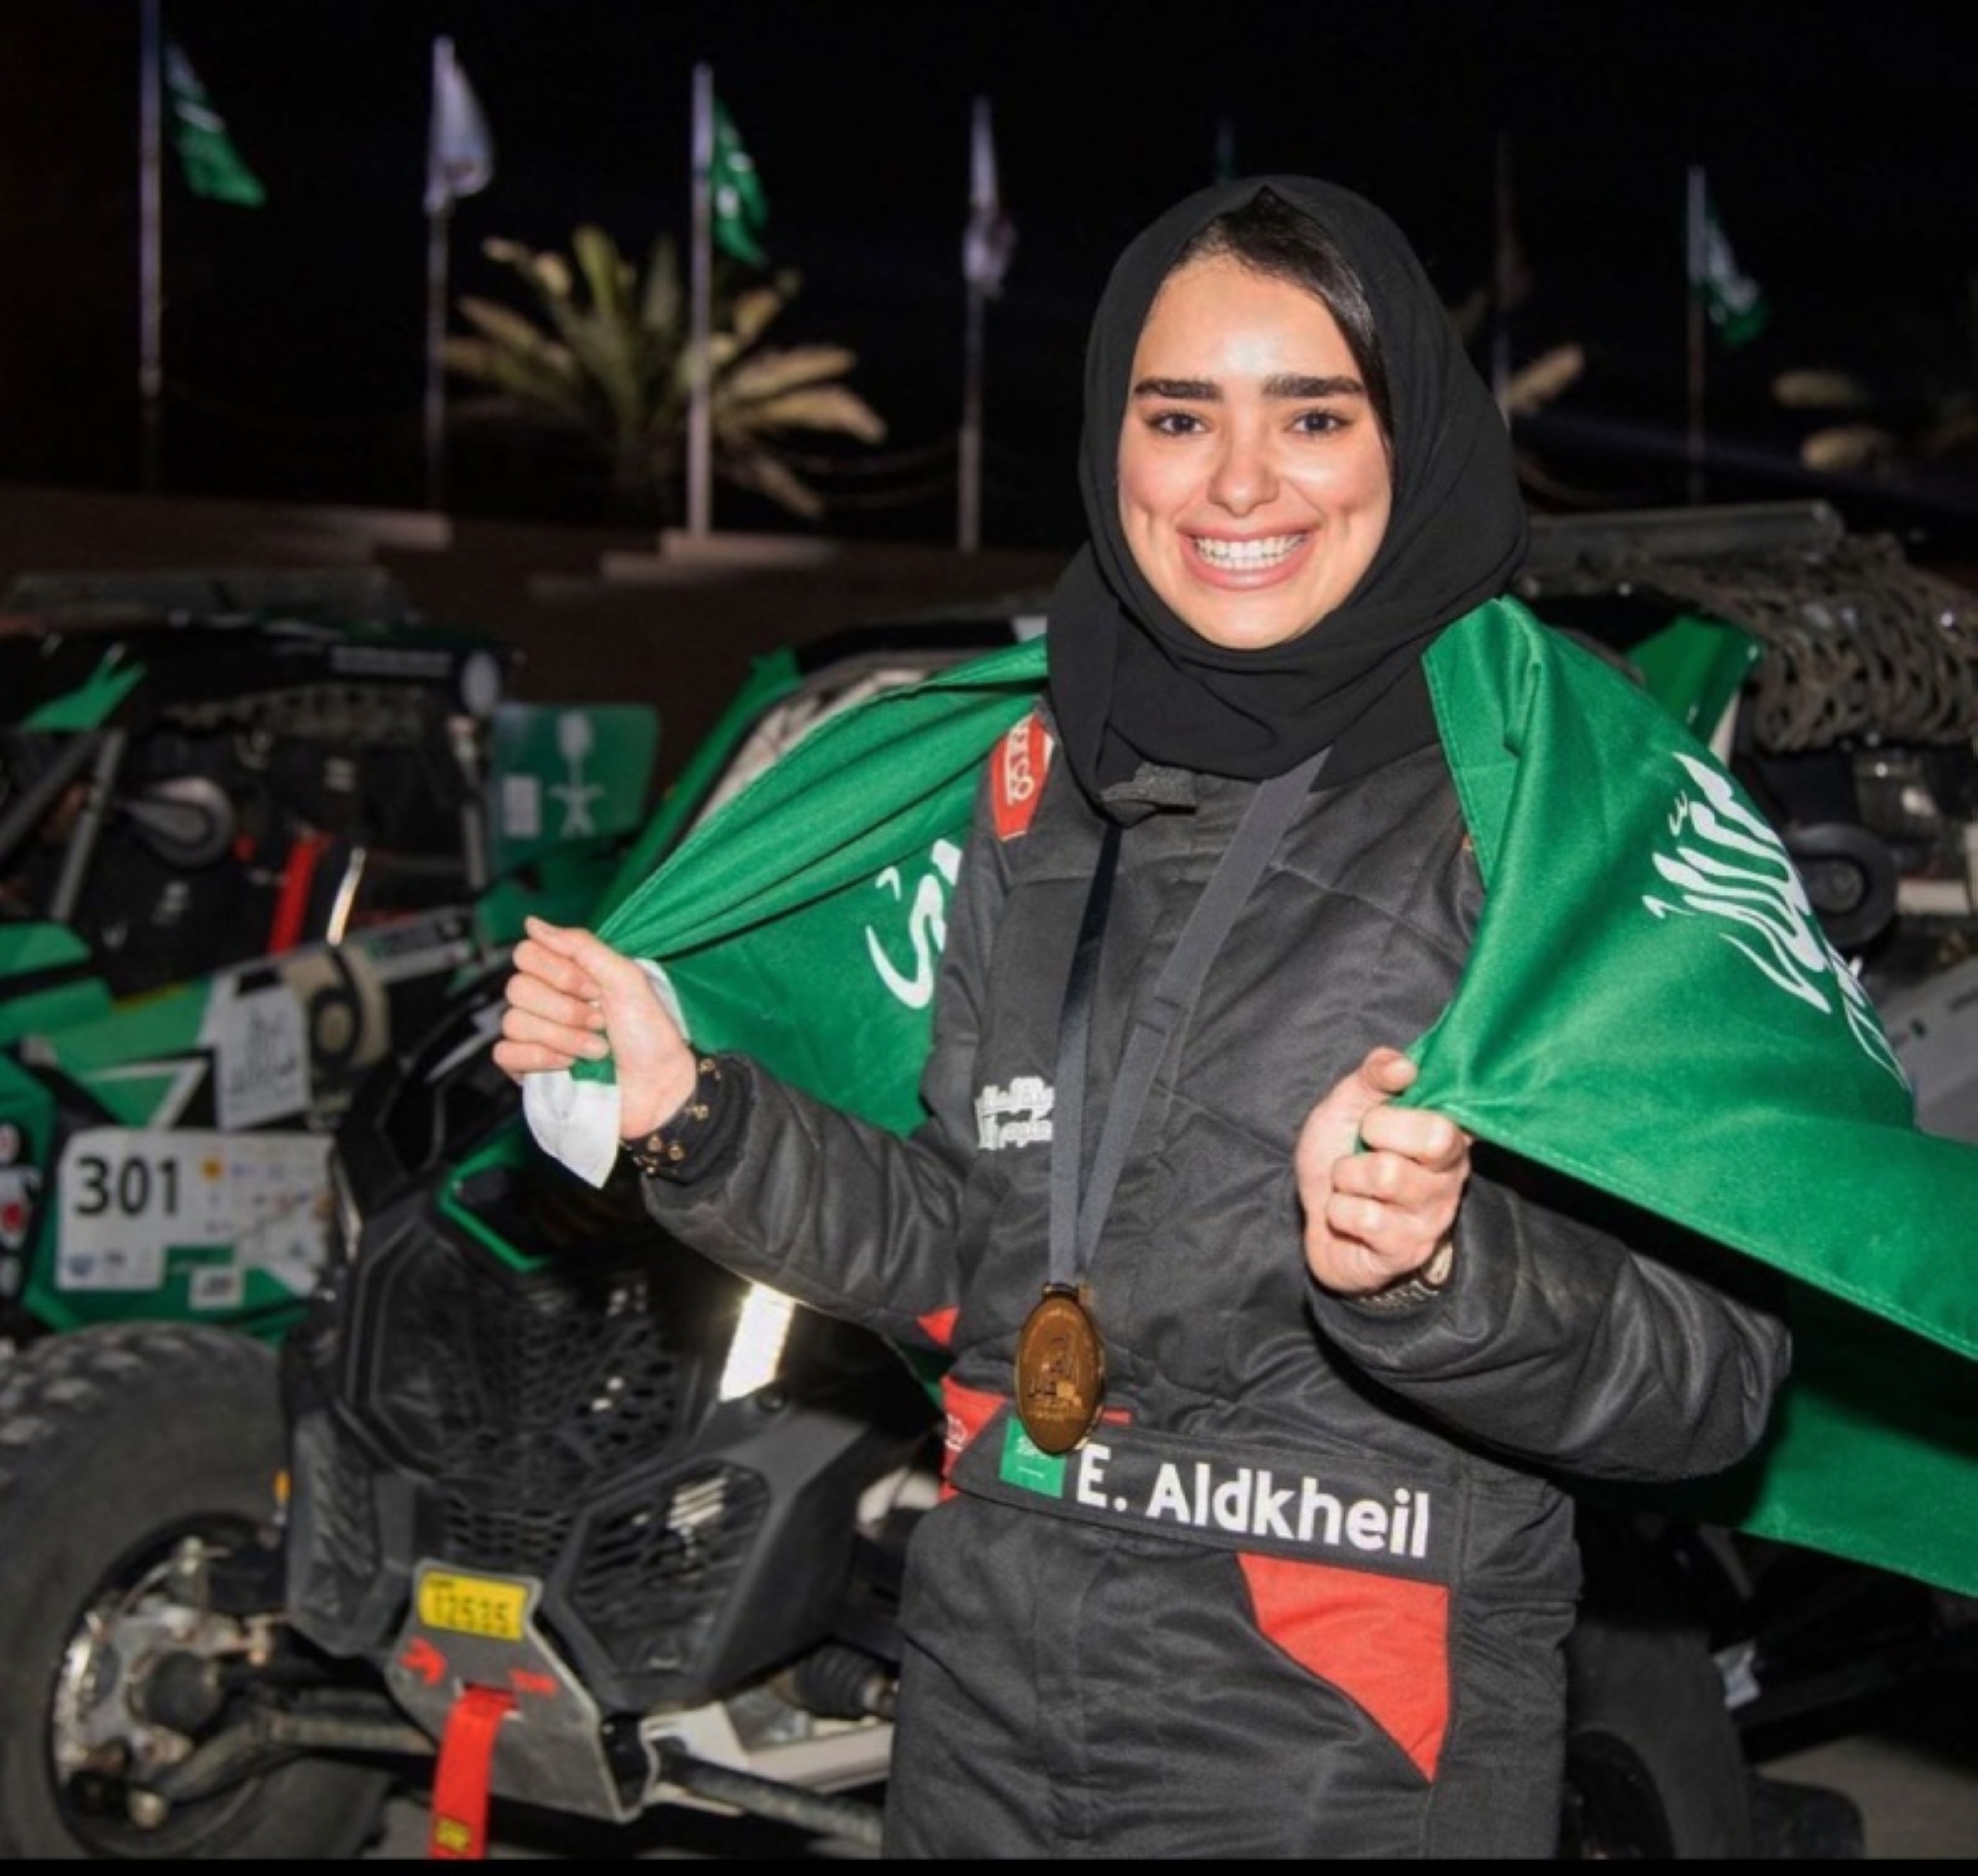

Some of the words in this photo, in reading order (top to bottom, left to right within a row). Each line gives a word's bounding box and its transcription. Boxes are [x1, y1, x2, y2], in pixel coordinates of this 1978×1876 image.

[74, 1155, 179, 1217] 301
[1075, 1443, 1127, 1512] E.
[1144, 1461, 1430, 1559] Aldkheil
